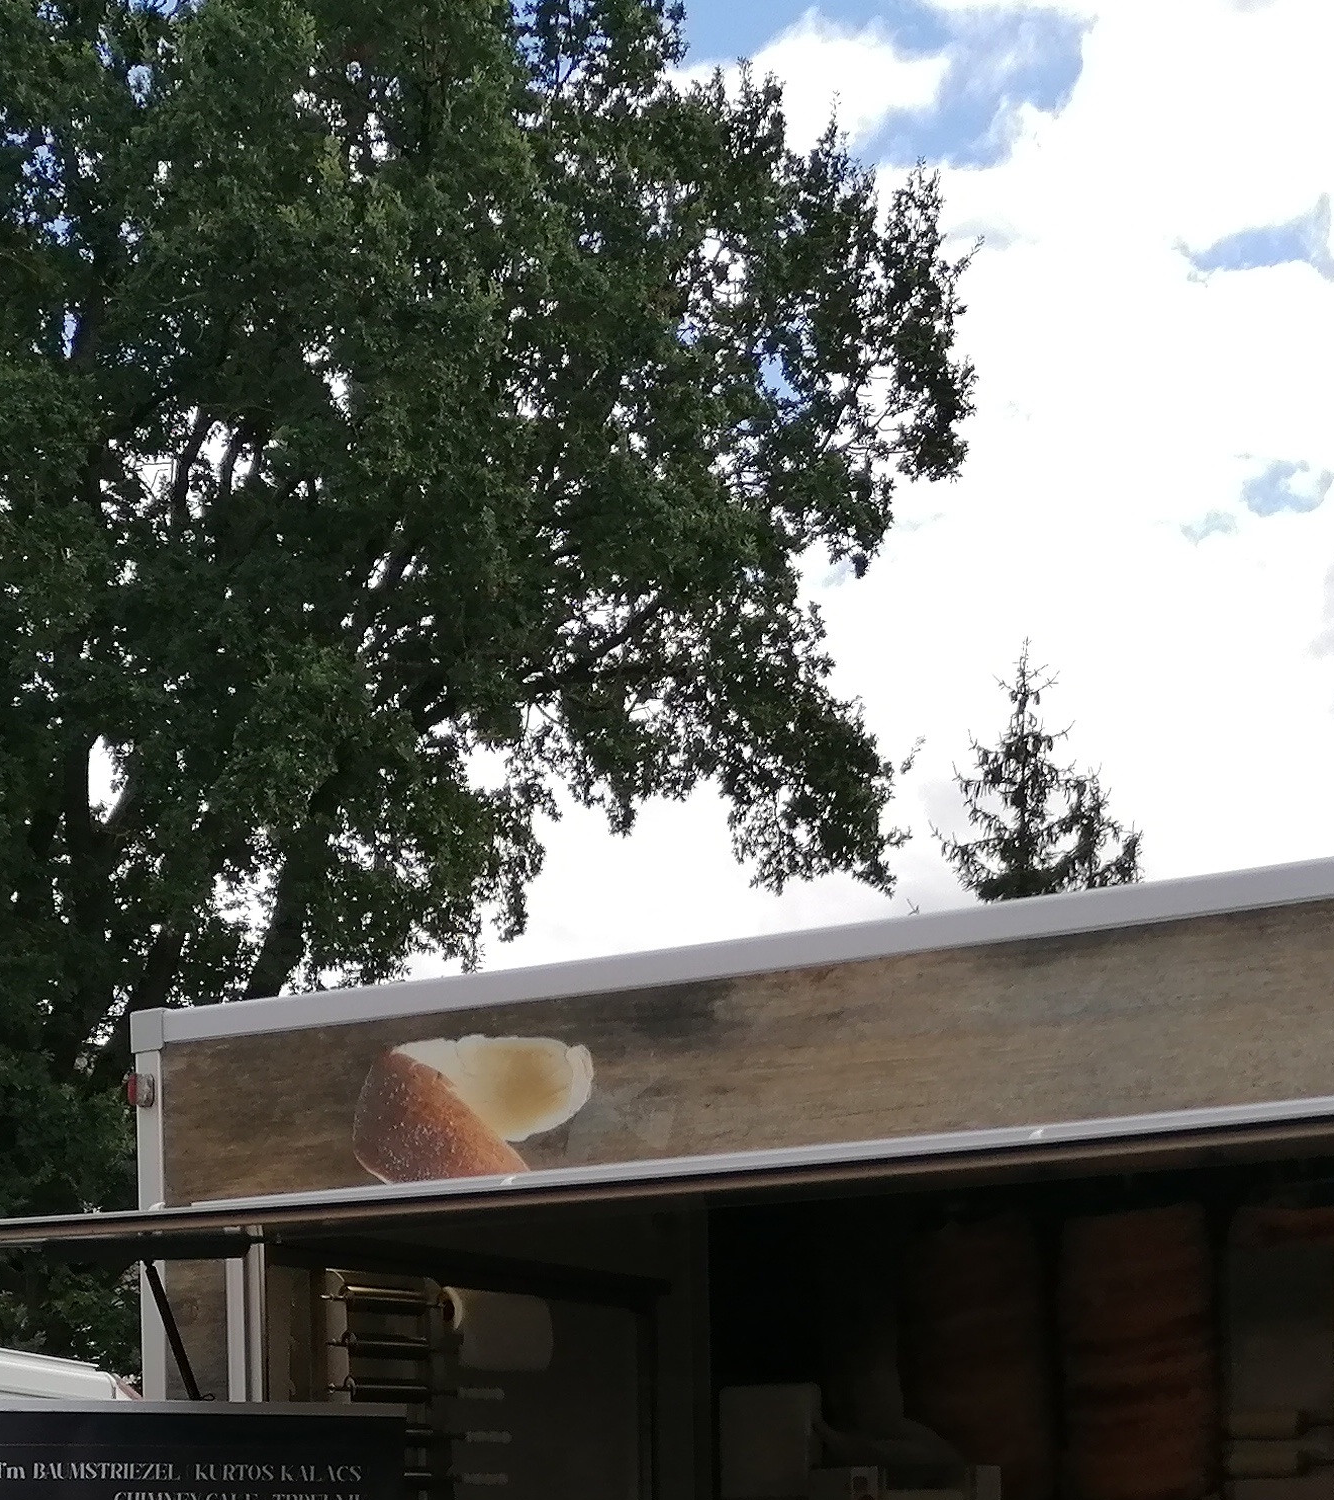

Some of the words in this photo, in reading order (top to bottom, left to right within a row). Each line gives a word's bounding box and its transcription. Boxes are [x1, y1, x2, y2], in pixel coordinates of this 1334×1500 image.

[32, 1462, 181, 1482] BAUMSTRIEZEL
[195, 1463, 274, 1482] KURTOS
[281, 1464, 363, 1482] KALACS
